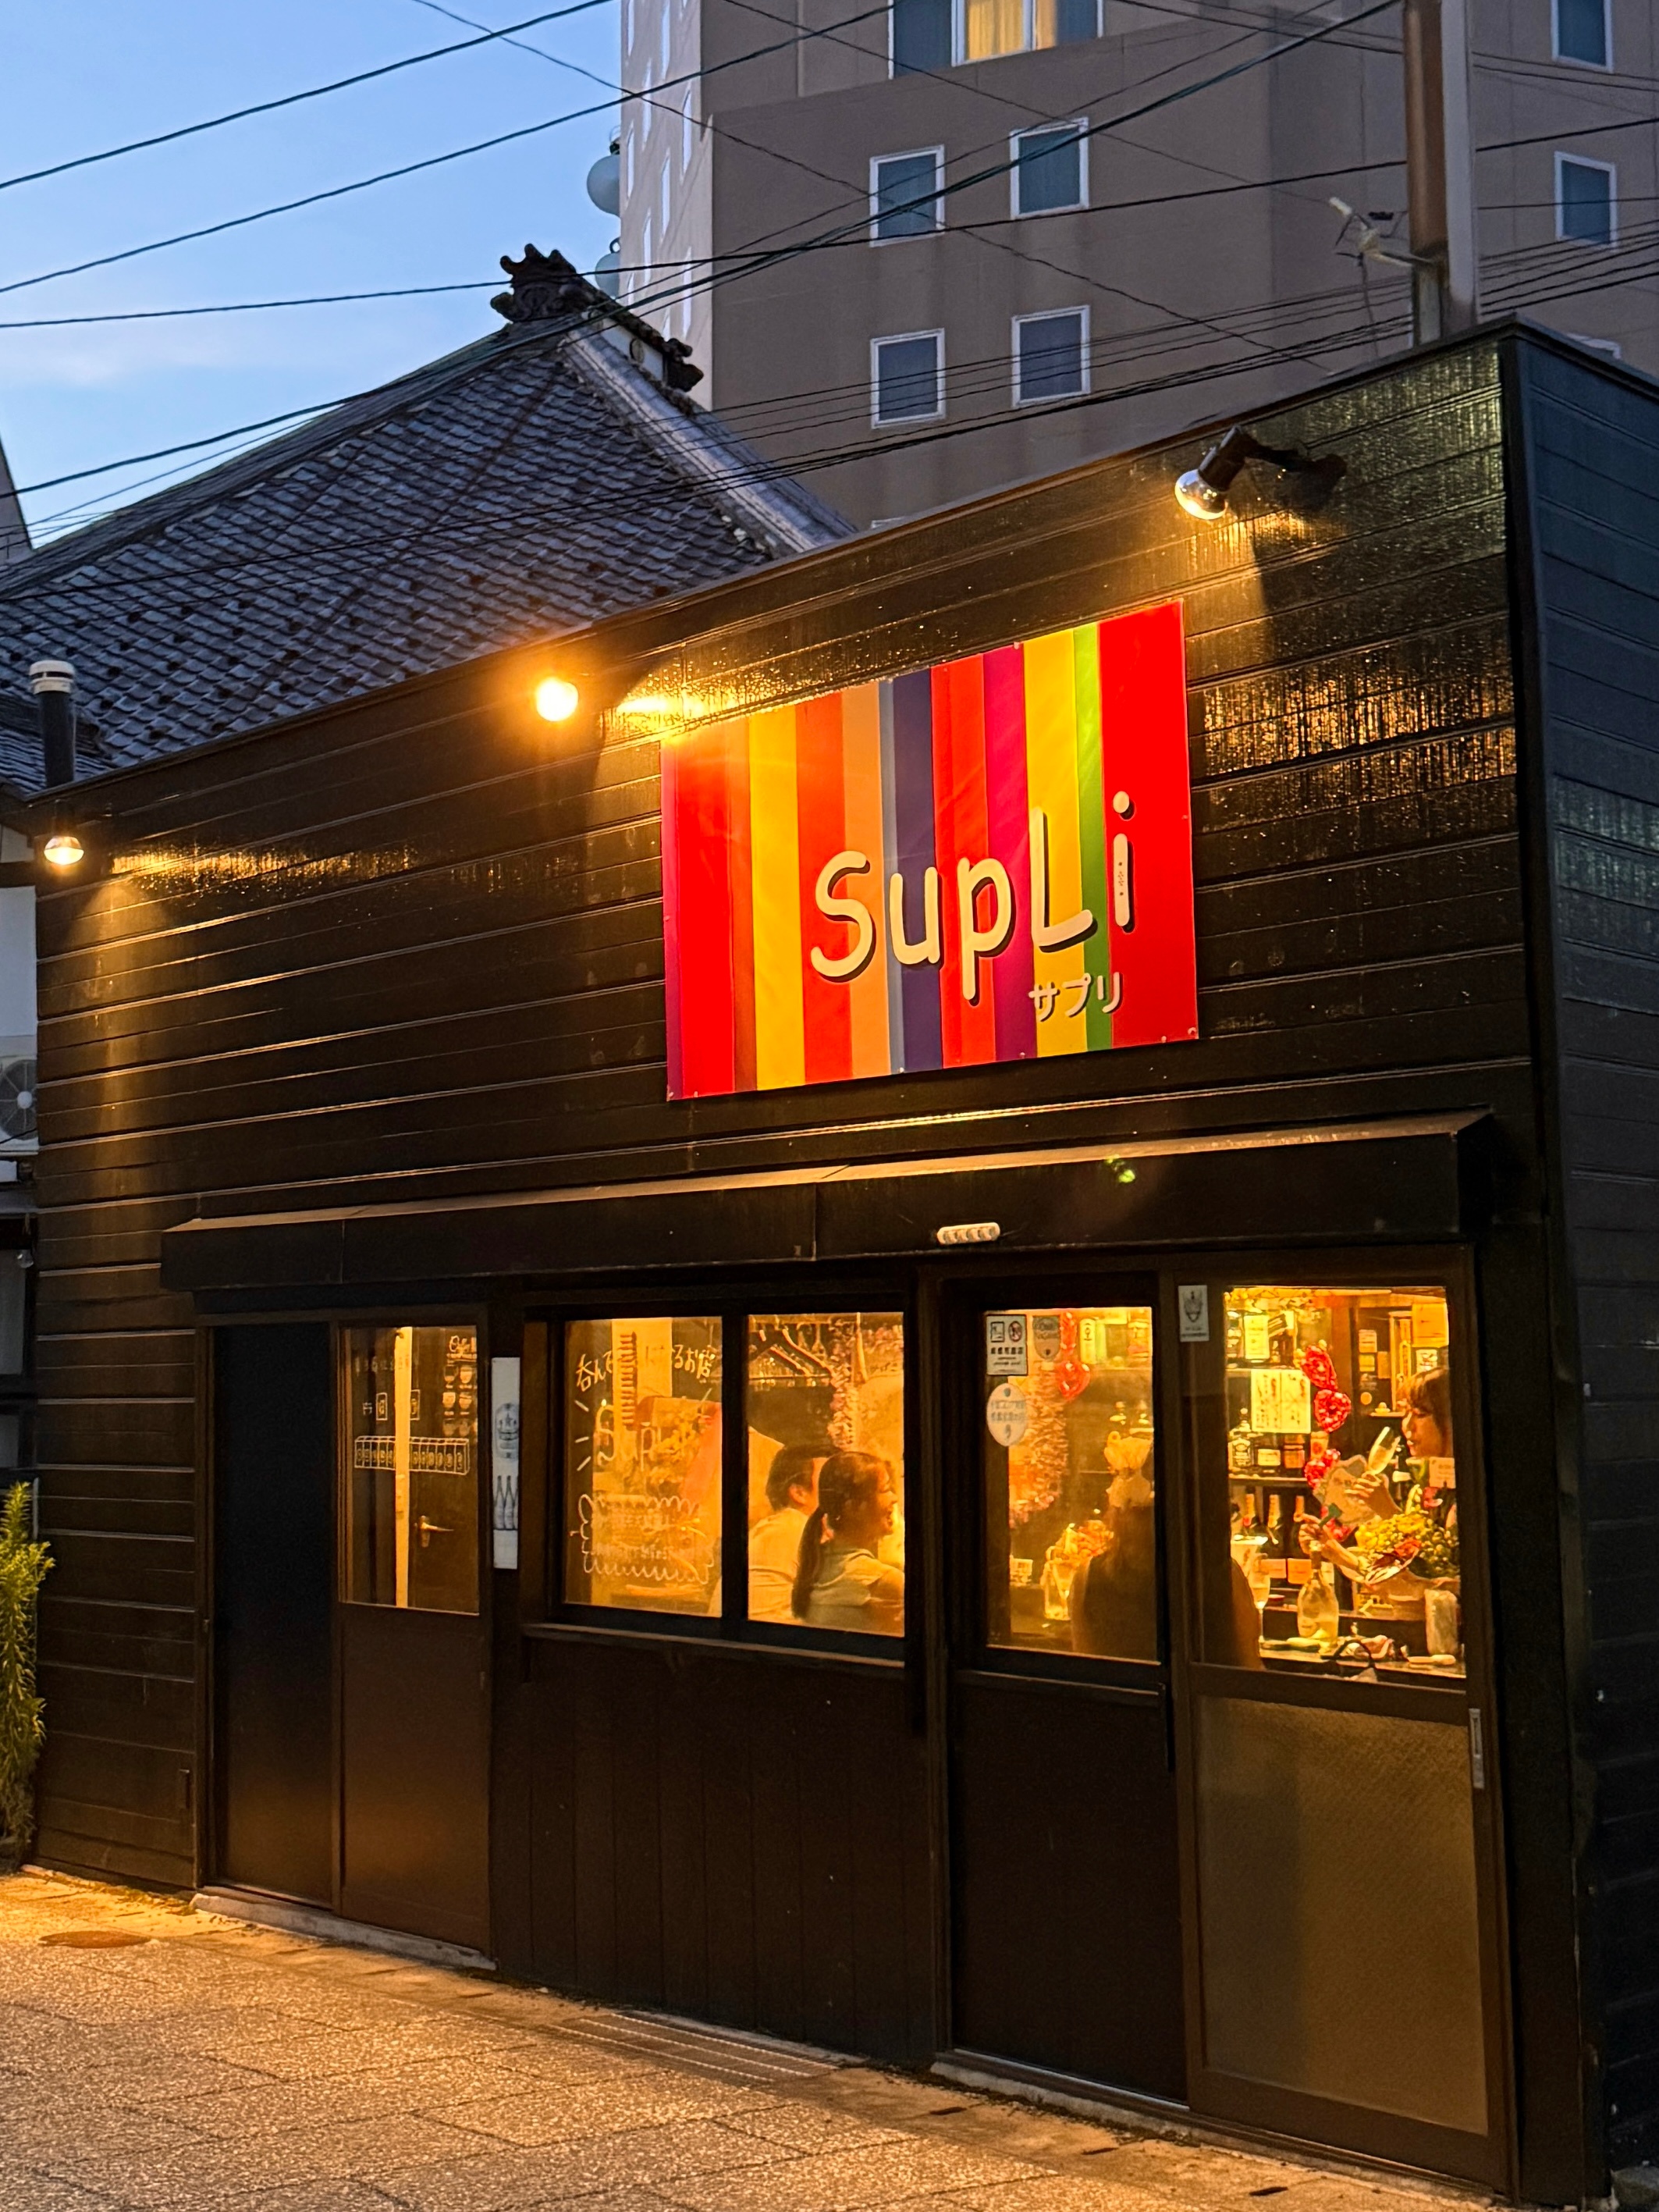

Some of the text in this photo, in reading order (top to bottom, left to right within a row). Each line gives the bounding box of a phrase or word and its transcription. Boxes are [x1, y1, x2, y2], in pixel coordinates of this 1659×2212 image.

[810, 791, 1133, 1004] SupLi
[1028, 971, 1123, 1021] サプリ
